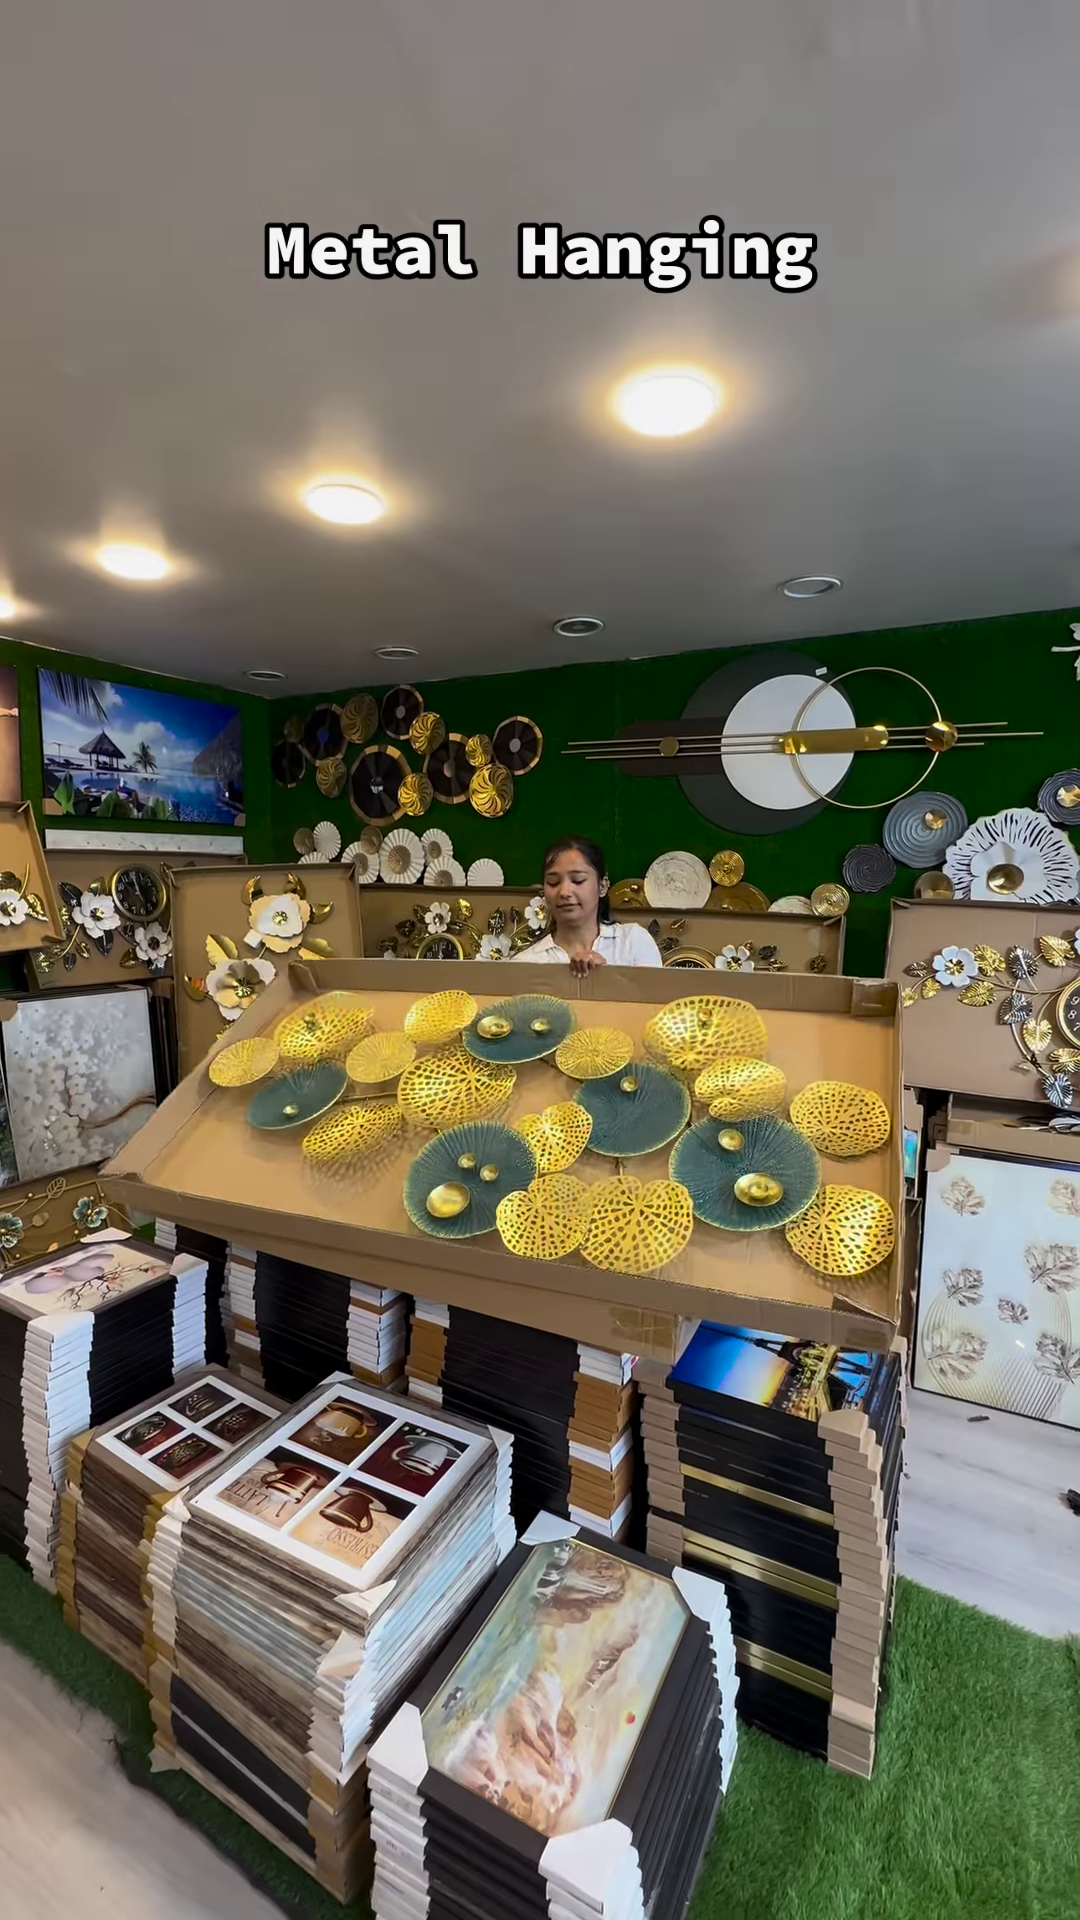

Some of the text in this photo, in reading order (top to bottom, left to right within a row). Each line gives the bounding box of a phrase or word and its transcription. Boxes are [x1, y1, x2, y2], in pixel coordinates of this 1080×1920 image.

[121, 874, 128, 882] 11
[146, 878, 152, 886] 2
[117, 892, 123, 900] 9
[123, 901, 129, 909] 8
[131, 906, 136, 914] 7
[140, 907, 145, 915] 6
[1070, 996, 1080, 1006] 9
[1067, 1009, 1077, 1020] 8
